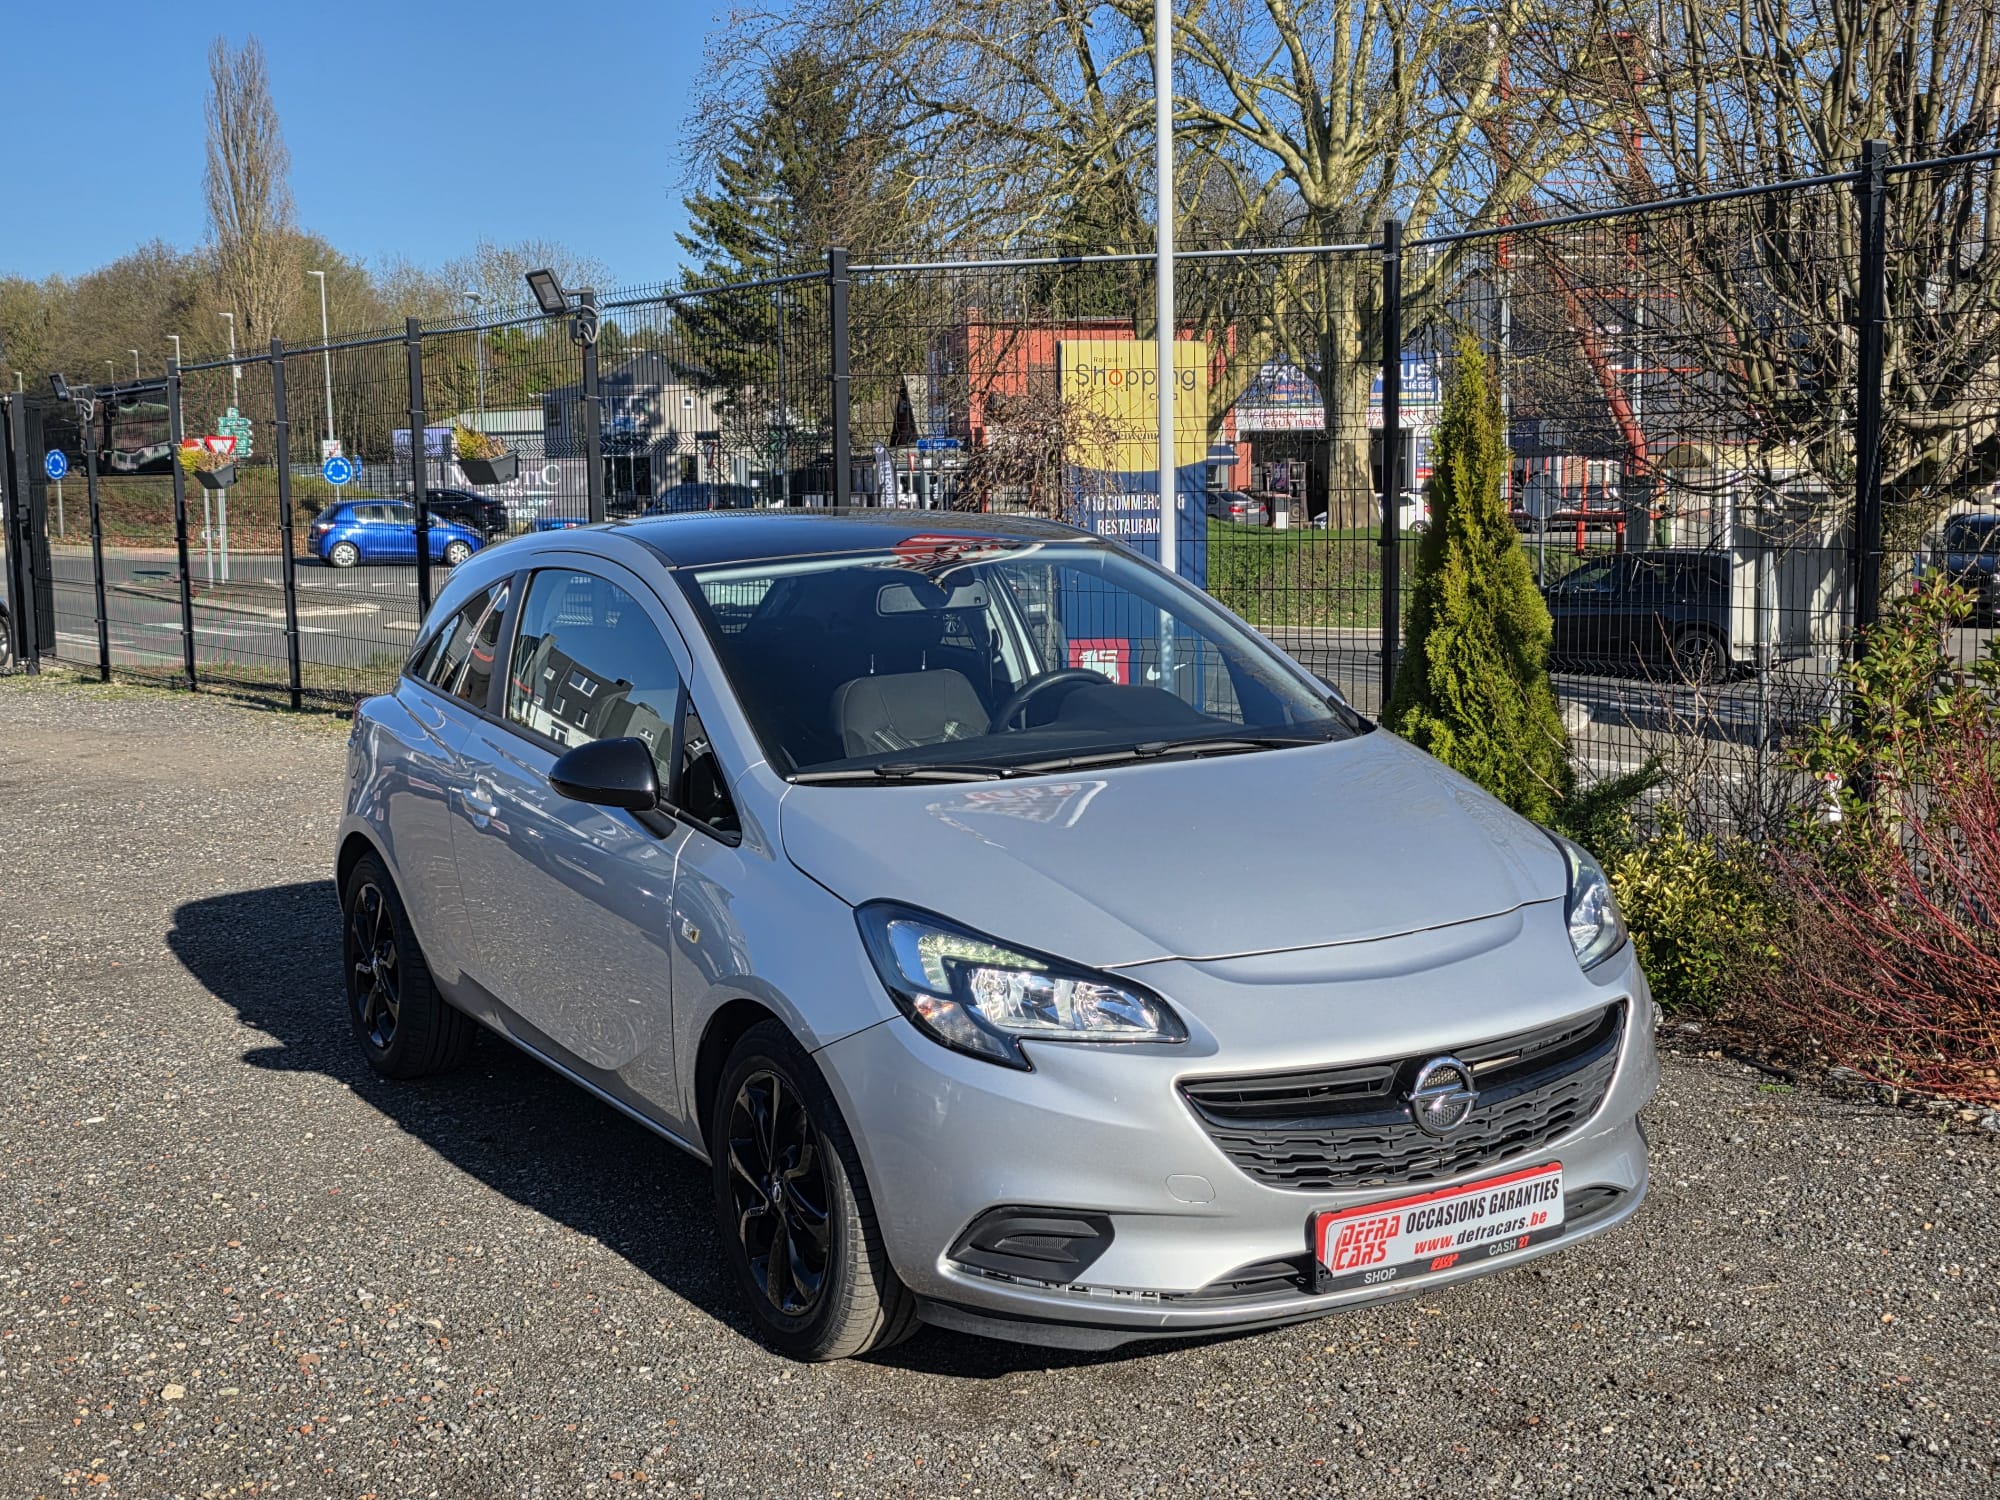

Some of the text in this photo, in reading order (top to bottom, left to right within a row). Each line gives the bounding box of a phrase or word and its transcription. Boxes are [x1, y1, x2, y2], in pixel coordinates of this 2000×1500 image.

[1107, 493, 1159, 511] COMMERC
[1097, 518, 1160, 535] RESTAURAN
[1406, 1178, 1560, 1234] OCCASIONS GARANTIES
[1341, 1215, 1401, 1247] DEFRA
[1414, 1211, 1548, 1254] www.defracars.be
[1334, 1240, 1387, 1271] CARS
[1489, 1235, 1530, 1256] CASH 27
[1364, 1267, 1396, 1284] SHOP
